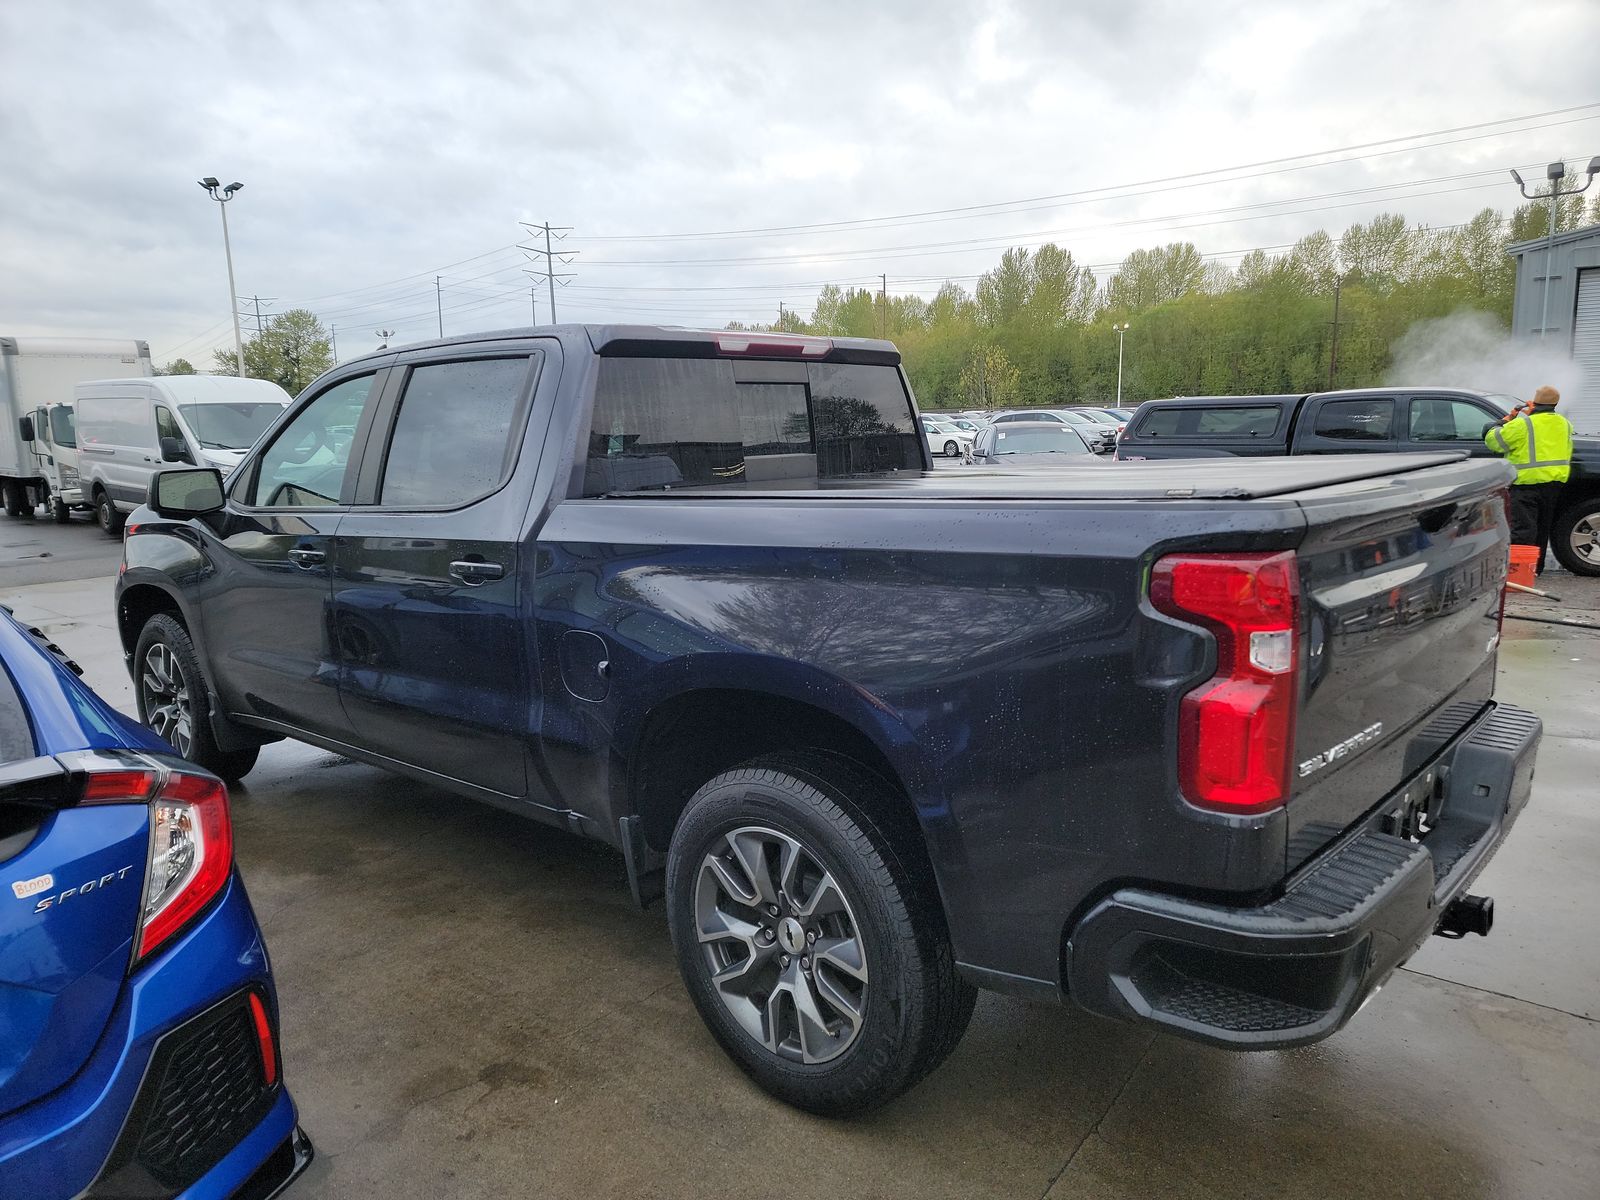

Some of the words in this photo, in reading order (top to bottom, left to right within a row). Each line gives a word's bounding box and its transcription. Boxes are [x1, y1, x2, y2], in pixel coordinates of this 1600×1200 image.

[1299, 722, 1382, 777] SILVERADO
[15, 877, 51, 895] BLOOD
[34, 865, 133, 914] SPORT
